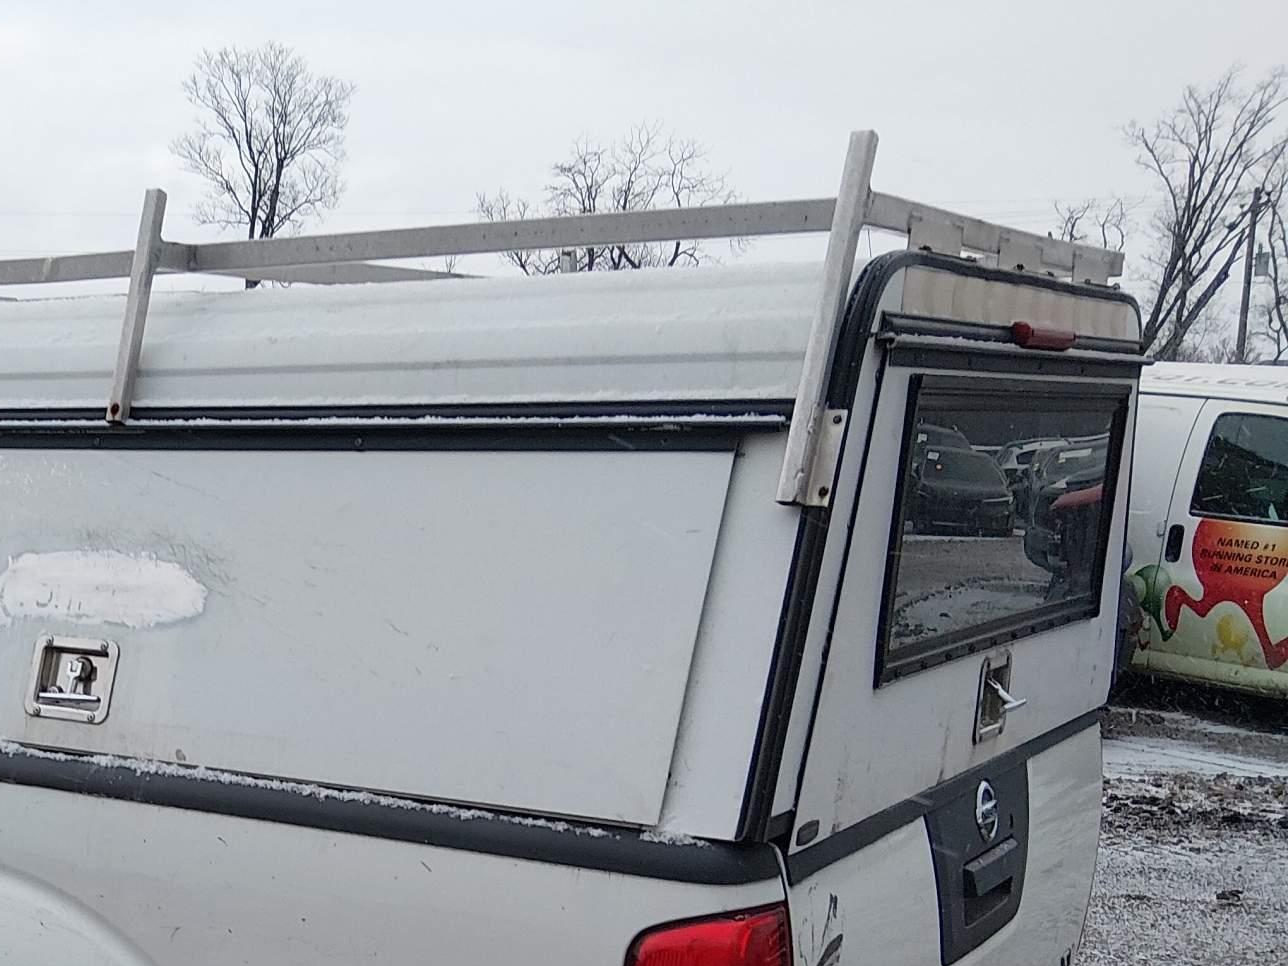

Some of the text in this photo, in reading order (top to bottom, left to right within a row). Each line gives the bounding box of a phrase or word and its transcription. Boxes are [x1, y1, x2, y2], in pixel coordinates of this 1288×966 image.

[1217, 537, 1260, 550] NAMED
[1200, 547, 1253, 563] RUNNING
[1224, 565, 1277, 579] AMERICA
